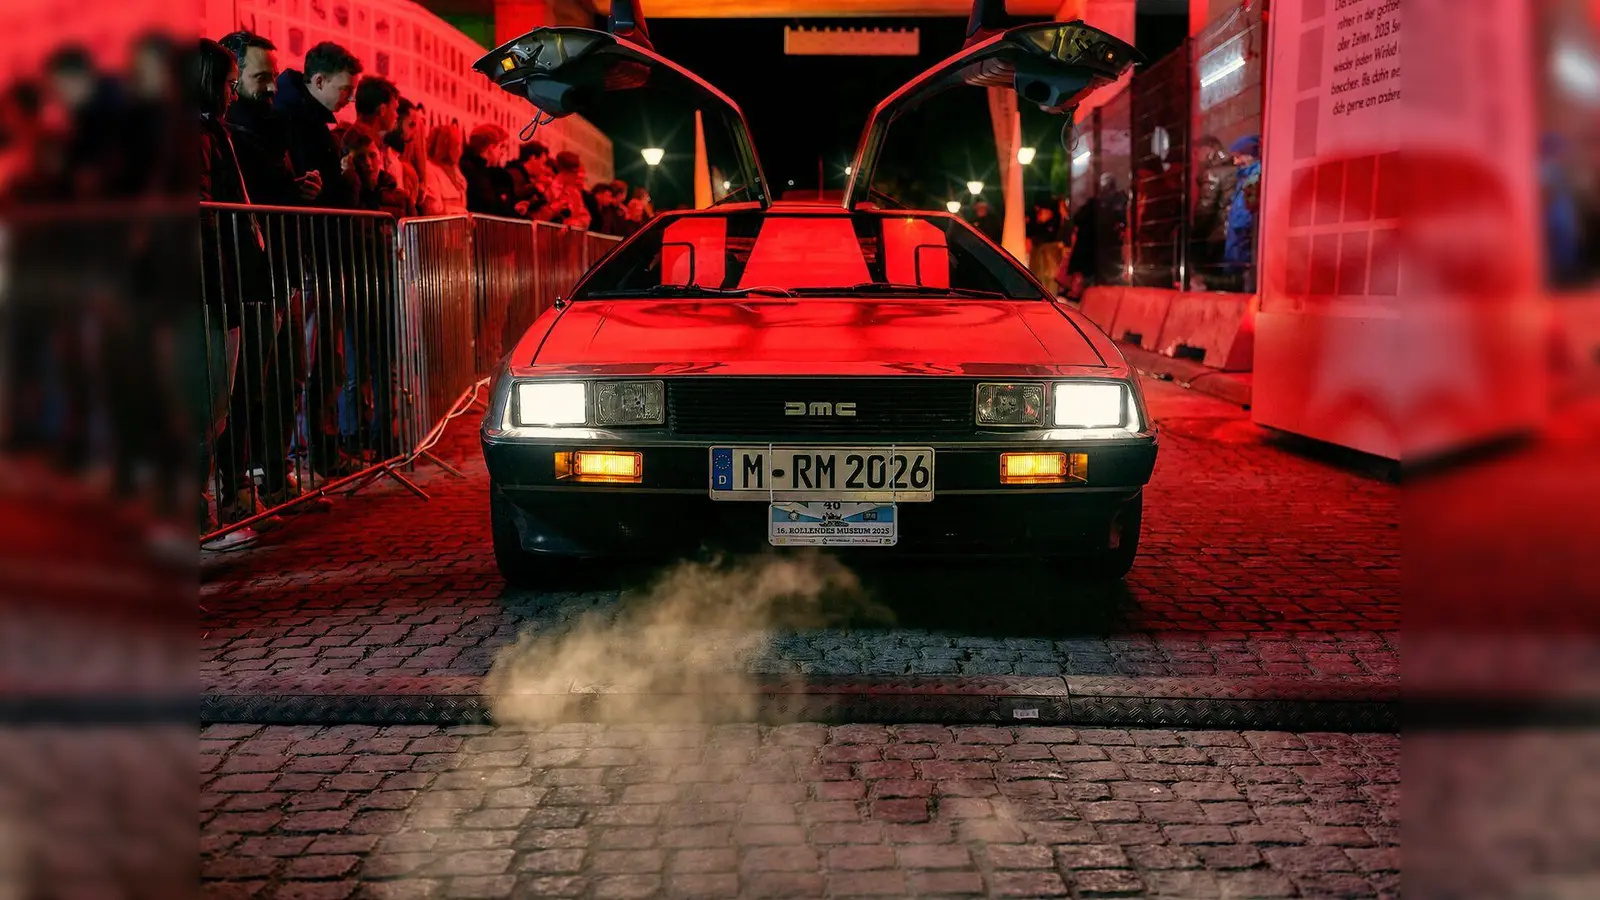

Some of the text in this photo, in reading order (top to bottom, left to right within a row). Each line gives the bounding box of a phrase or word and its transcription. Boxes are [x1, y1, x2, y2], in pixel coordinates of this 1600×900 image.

[845, 454, 930, 489] 2026
[718, 475, 727, 485] D
[872, 527, 890, 535] 2025
